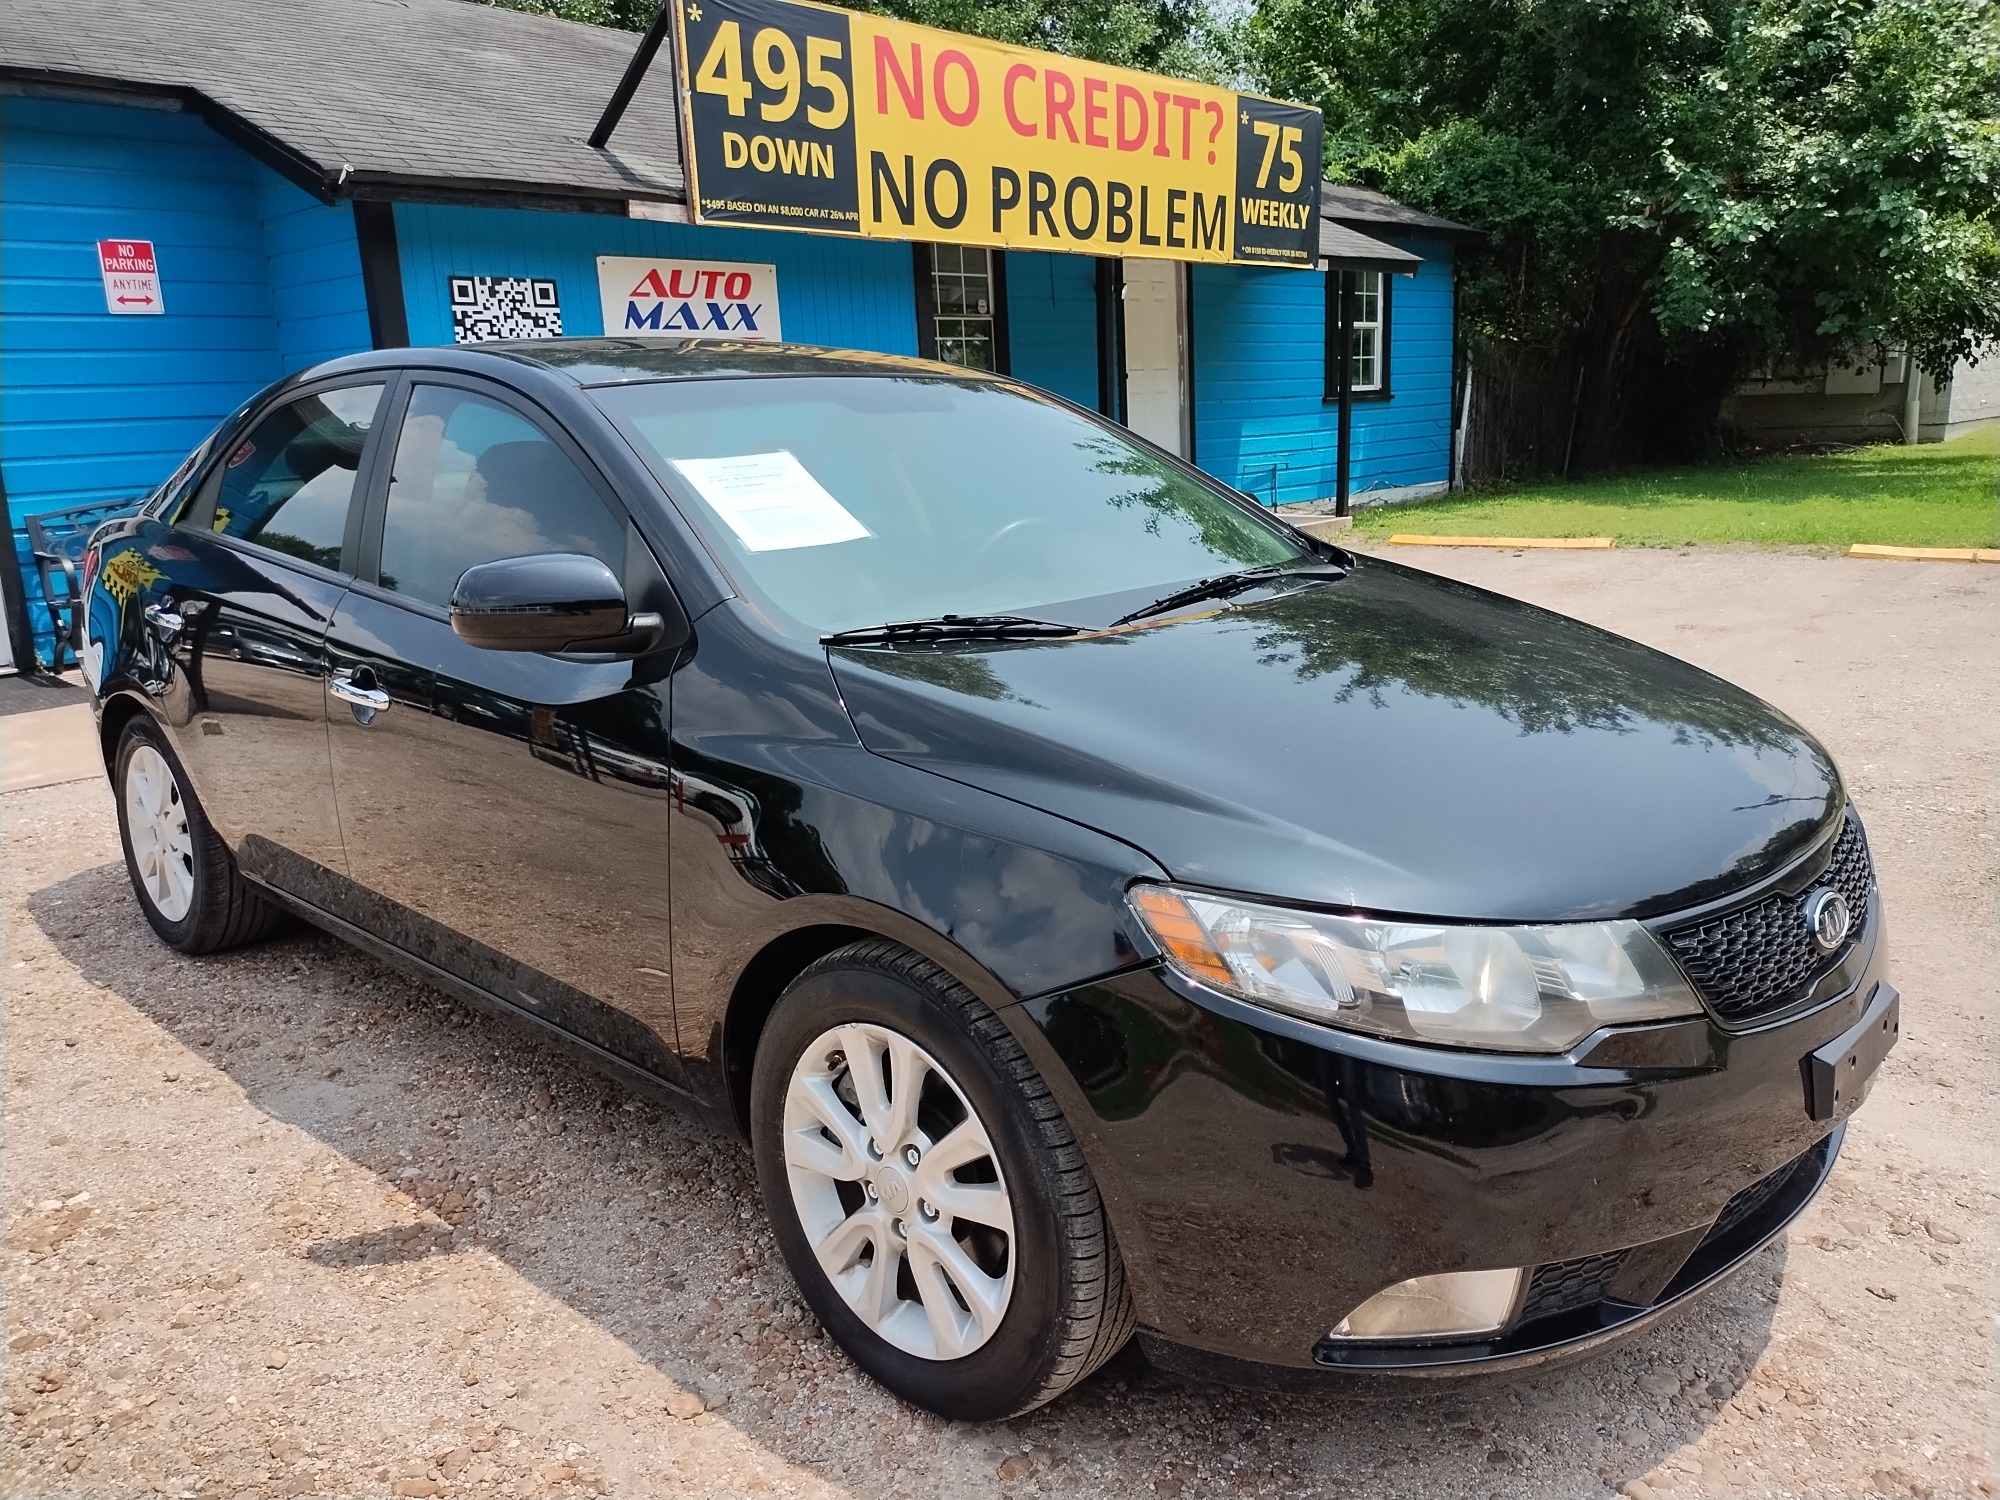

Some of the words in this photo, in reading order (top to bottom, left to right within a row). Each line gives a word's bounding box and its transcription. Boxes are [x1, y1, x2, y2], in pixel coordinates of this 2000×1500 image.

[873, 34, 980, 127] NO
[1003, 63, 1224, 166] CREDIT?
[722, 131, 835, 179] DOWN
[727, 200, 752, 212] BASED
[753, 203, 767, 213] ON
[767, 204, 779, 214] AN
[780, 205, 804, 217] $8,000
[804, 208, 819, 218] CAR
[819, 208, 829, 218] AT
[829, 209, 845, 220] 26%
[844, 211, 859, 222] APR
[870, 150, 968, 229] NO
[991, 165, 1227, 252] PROBLEM
[1241, 197, 1311, 230] WEEKLY
[104, 257, 154, 271] PARKING
[118, 244, 135, 258] NO
[113, 279, 154, 291] ANYTIME
[629, 268, 752, 300] AUTO
[624, 300, 763, 331] MAXX
[882, 1180, 903, 1202] KIA
